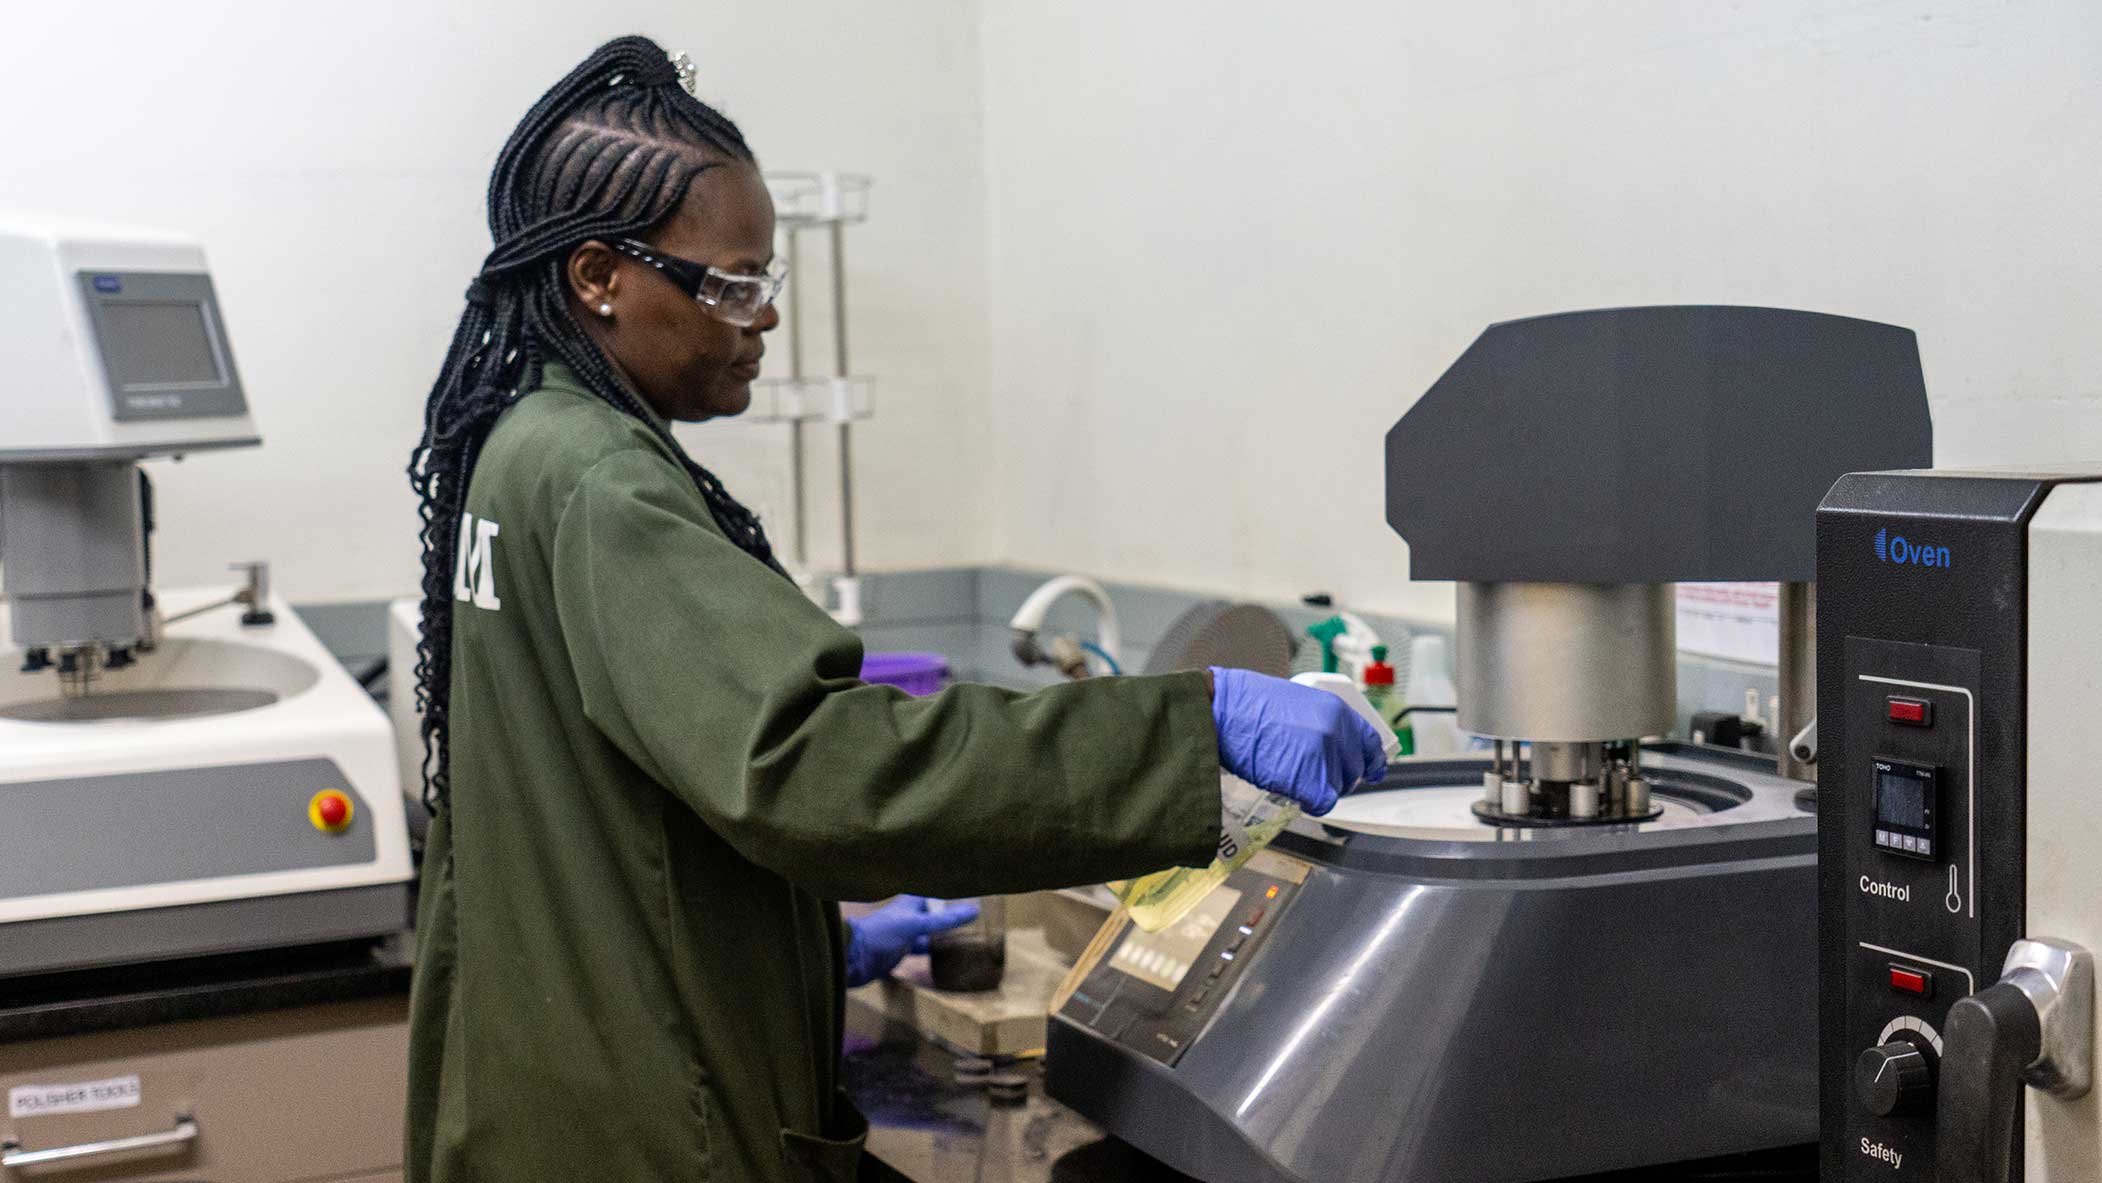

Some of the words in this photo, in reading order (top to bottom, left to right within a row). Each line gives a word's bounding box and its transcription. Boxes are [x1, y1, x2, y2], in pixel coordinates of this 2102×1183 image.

[453, 512, 501, 611] M
[1890, 536, 1951, 568] Oven
[1860, 875, 1910, 902] Control
[1861, 1137, 1903, 1169] Safety
